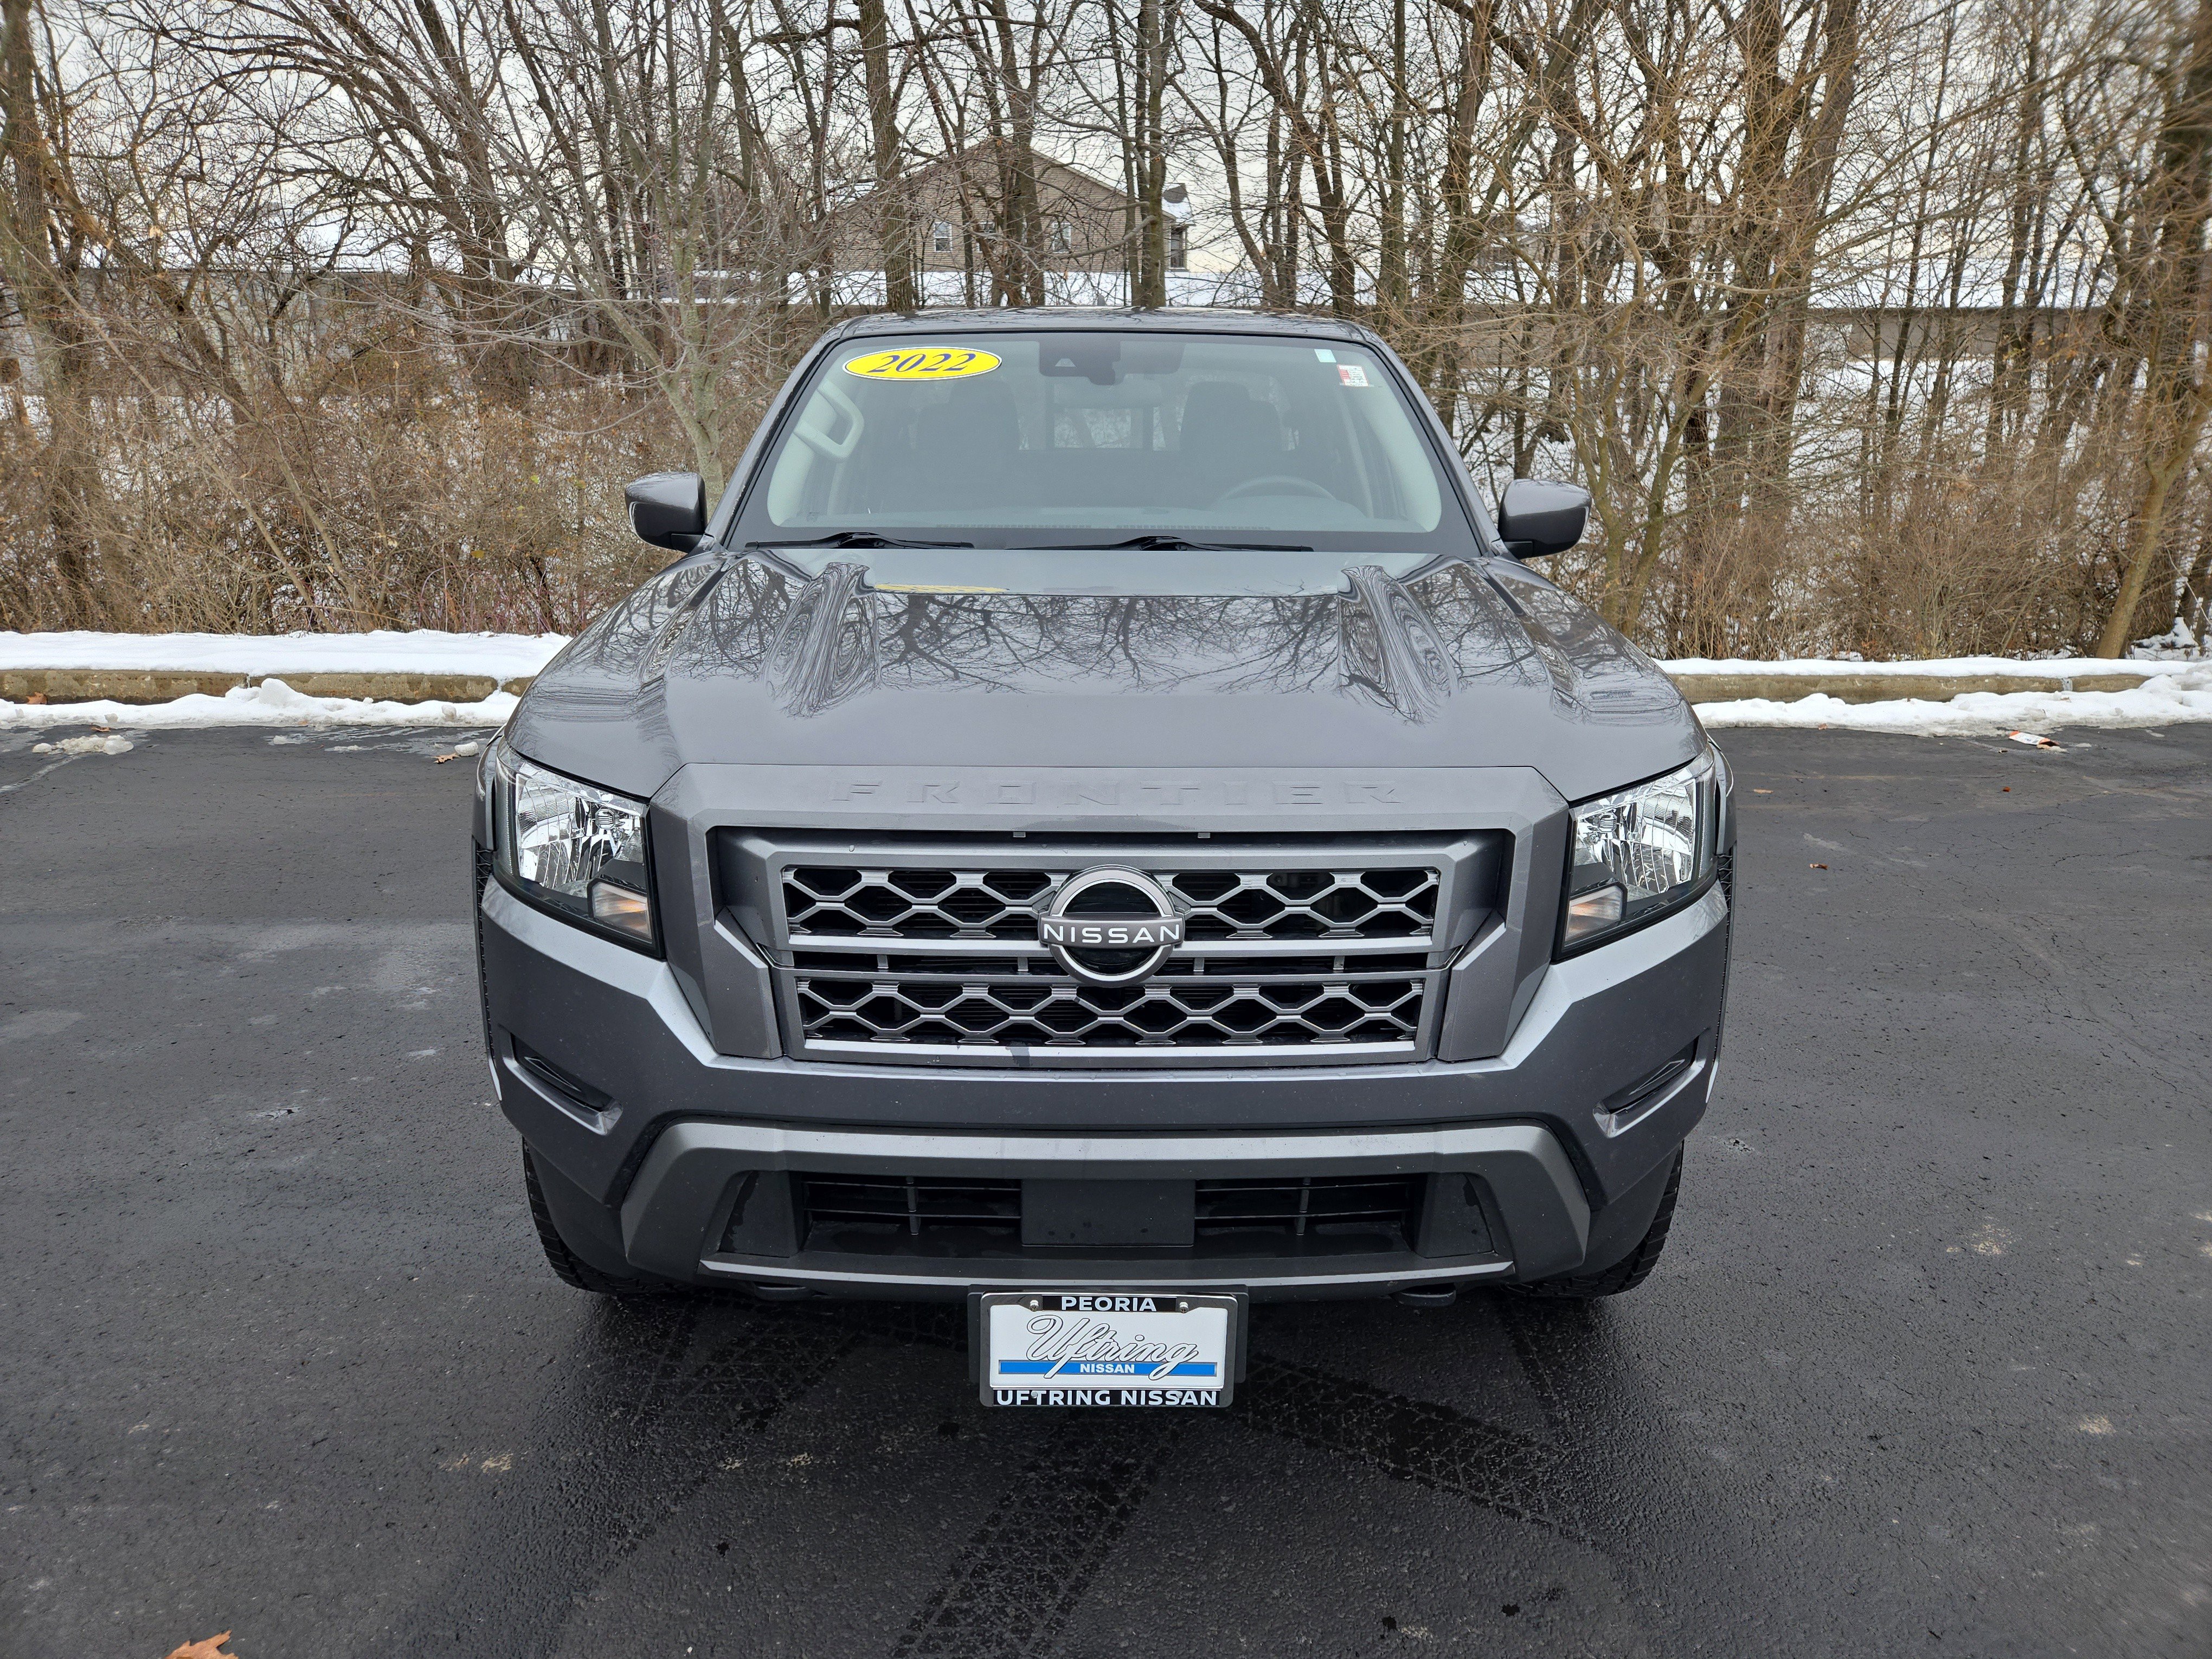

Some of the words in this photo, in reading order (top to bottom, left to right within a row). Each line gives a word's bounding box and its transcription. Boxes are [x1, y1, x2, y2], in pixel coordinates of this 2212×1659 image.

[866, 353, 976, 373] 2022
[828, 779, 1405, 805] FRONTIER
[1043, 923, 1180, 944] NISSAN
[1061, 1296, 1157, 1312] PEORIA
[1026, 1314, 1199, 1380] Uftring
[1080, 1364, 1135, 1374] NISSAN
[996, 1389, 1111, 1405] UFTRING
[1120, 1390, 1217, 1406] NISSAN
